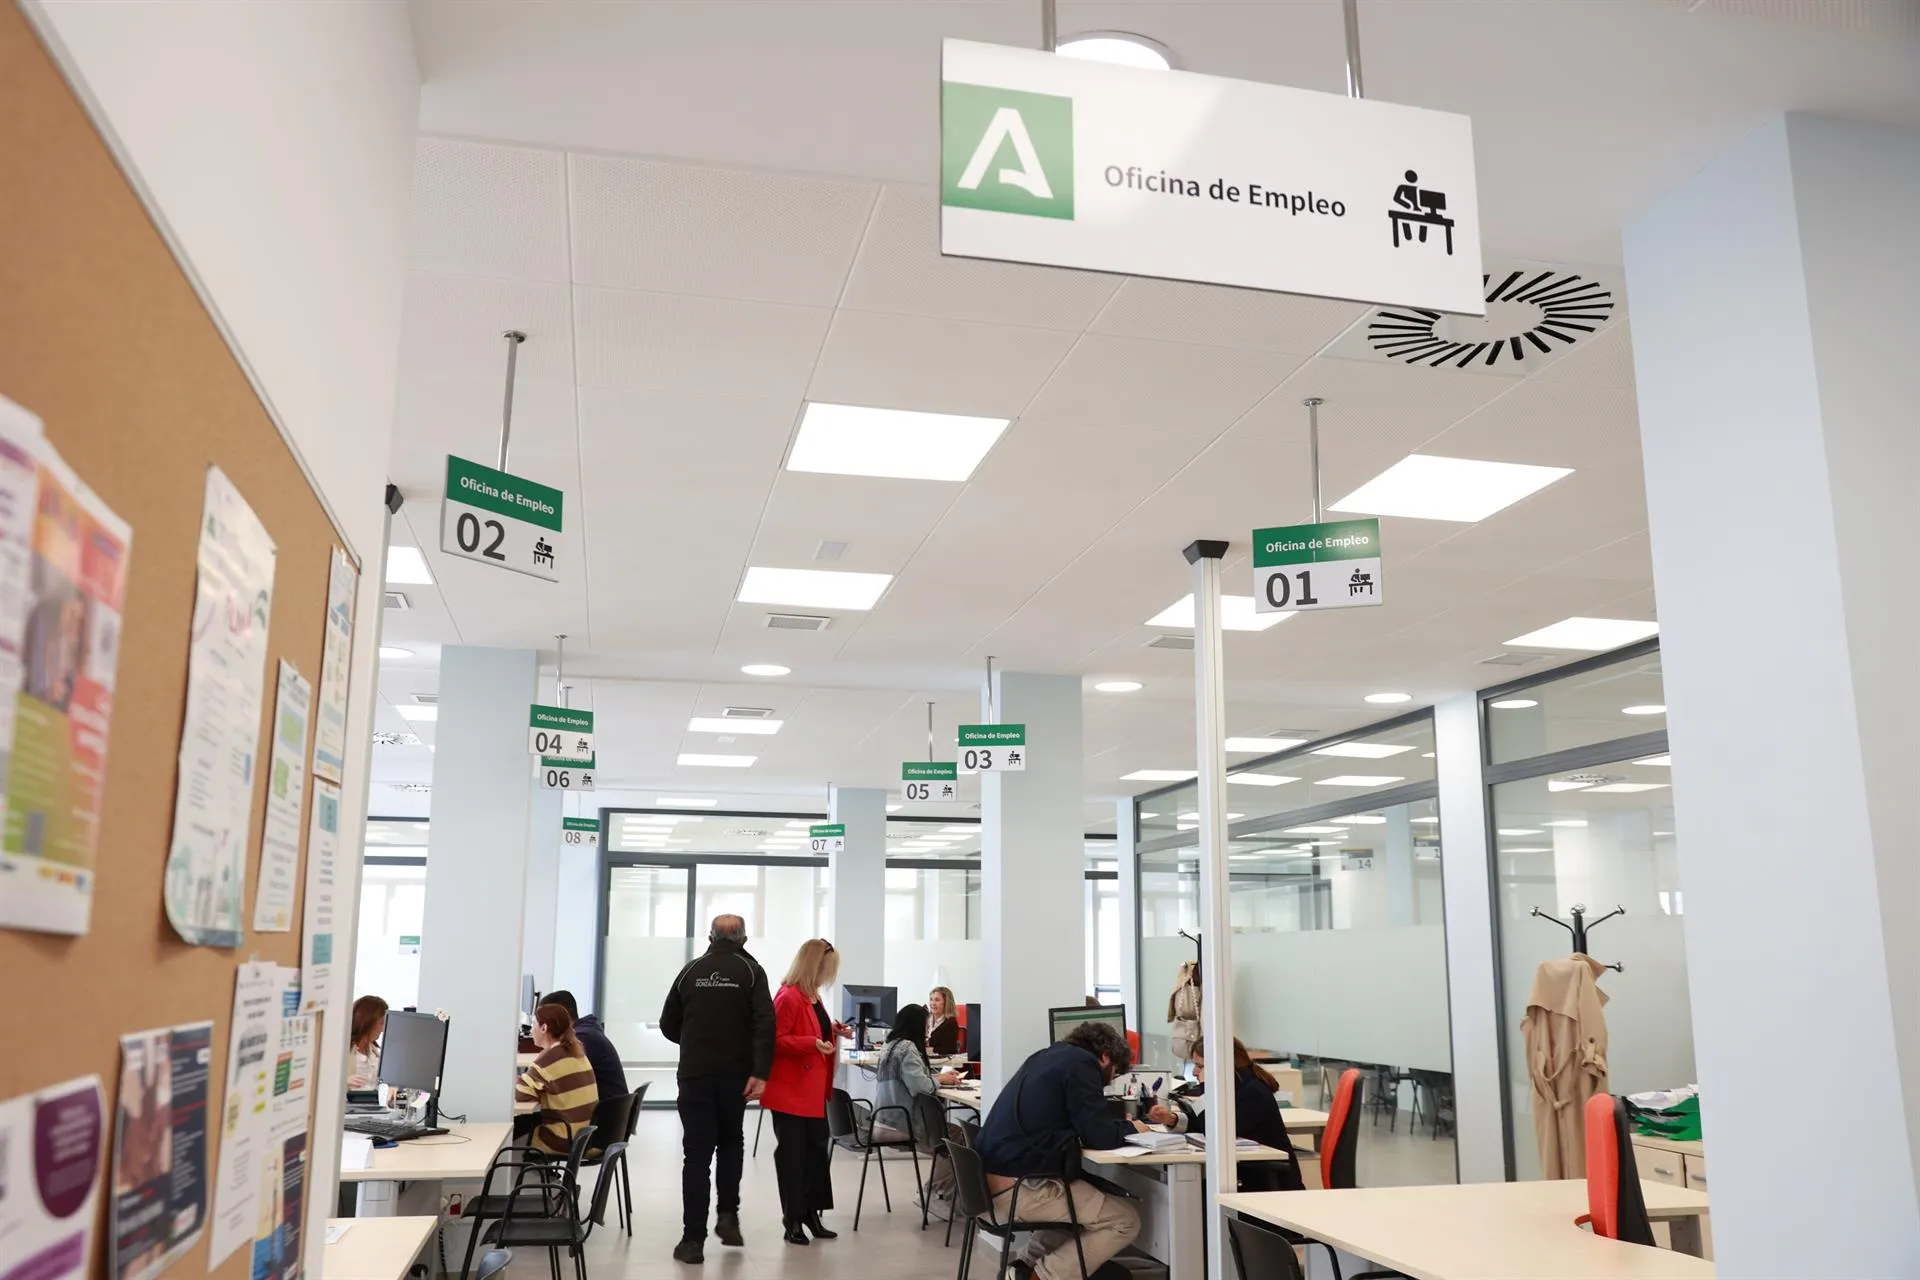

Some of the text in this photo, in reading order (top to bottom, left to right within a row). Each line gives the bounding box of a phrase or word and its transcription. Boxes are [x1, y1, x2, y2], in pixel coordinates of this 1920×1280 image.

[1104, 165, 1346, 219] Oficina de Empleo
[460, 476, 555, 515] Oficina de Empleo
[456, 512, 506, 562] 02
[1265, 534, 1369, 553] Oficina de Empleo
[1266, 570, 1318, 608] 01
[537, 713, 558, 722] Oficina
[567, 717, 589, 726] Empleo
[535, 732, 563, 754] 04
[964, 732, 987, 740] Oficina
[996, 731, 1021, 740] Empleo
[964, 749, 993, 770] 03
[547, 769, 570, 788] 06
[933, 768, 953, 776] Empleo
[906, 783, 930, 800] 05
[565, 831, 581, 844] 08
[811, 839, 827, 851] 07
